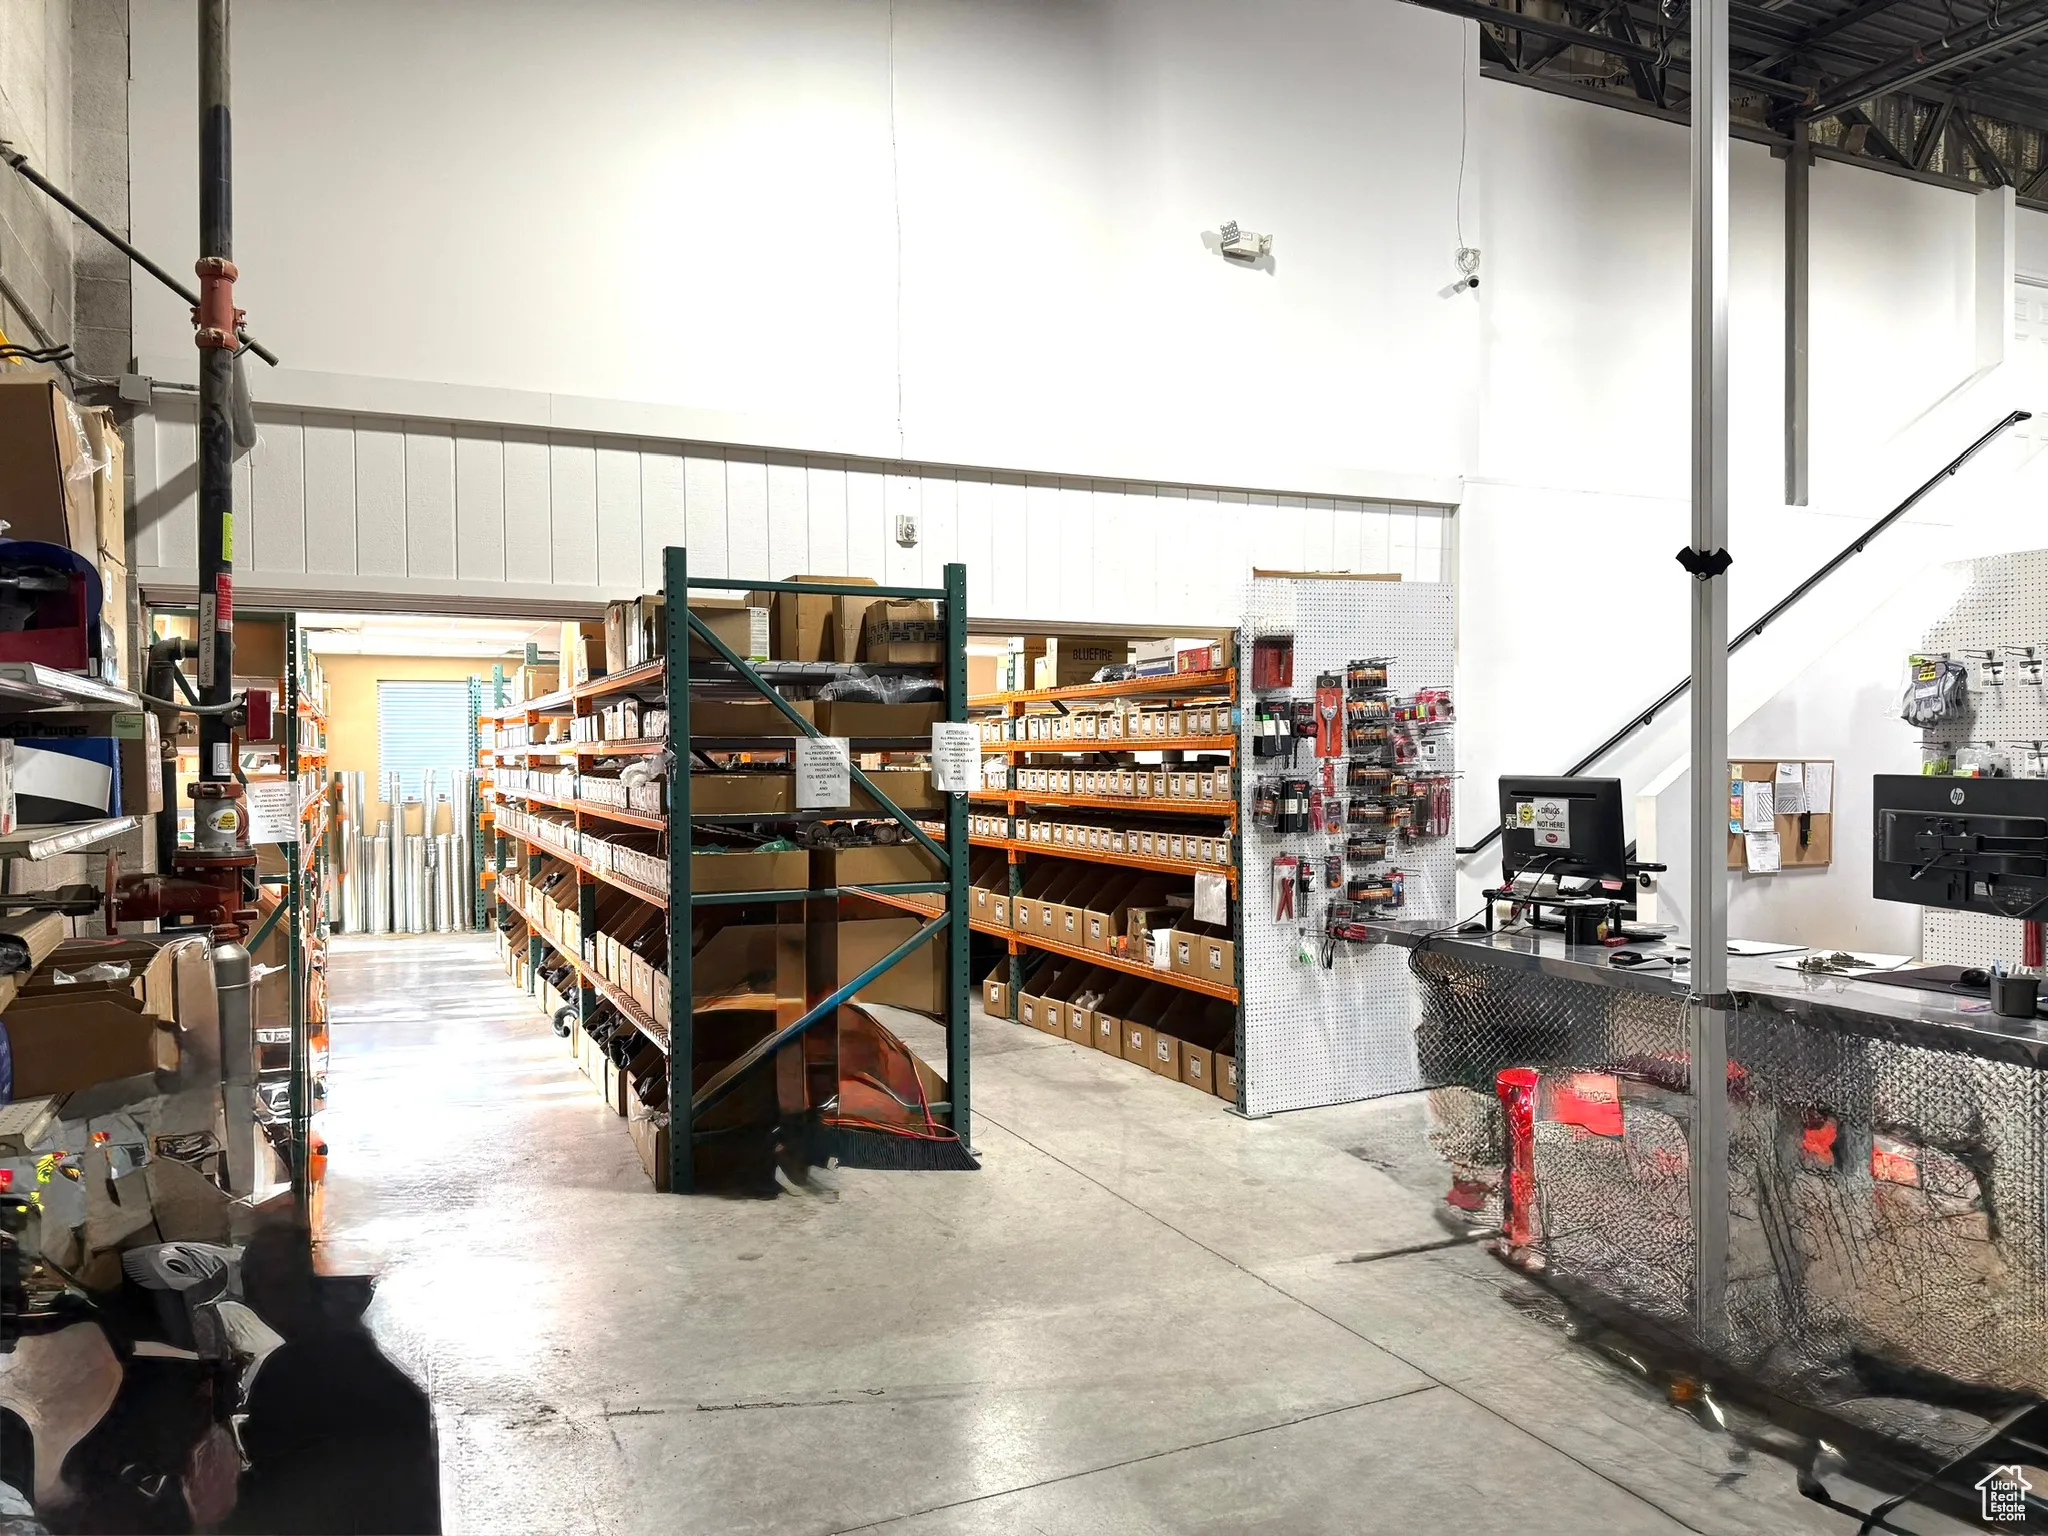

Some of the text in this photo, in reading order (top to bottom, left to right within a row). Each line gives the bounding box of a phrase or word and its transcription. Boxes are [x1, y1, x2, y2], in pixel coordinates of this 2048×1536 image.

[904, 622, 925, 630] IPS
[890, 632, 910, 641] IPS
[1072, 648, 1113, 661] BLUEFIRE
[1952, 788, 1964, 805] hp
[1537, 820, 1566, 828] NOT HERE!
